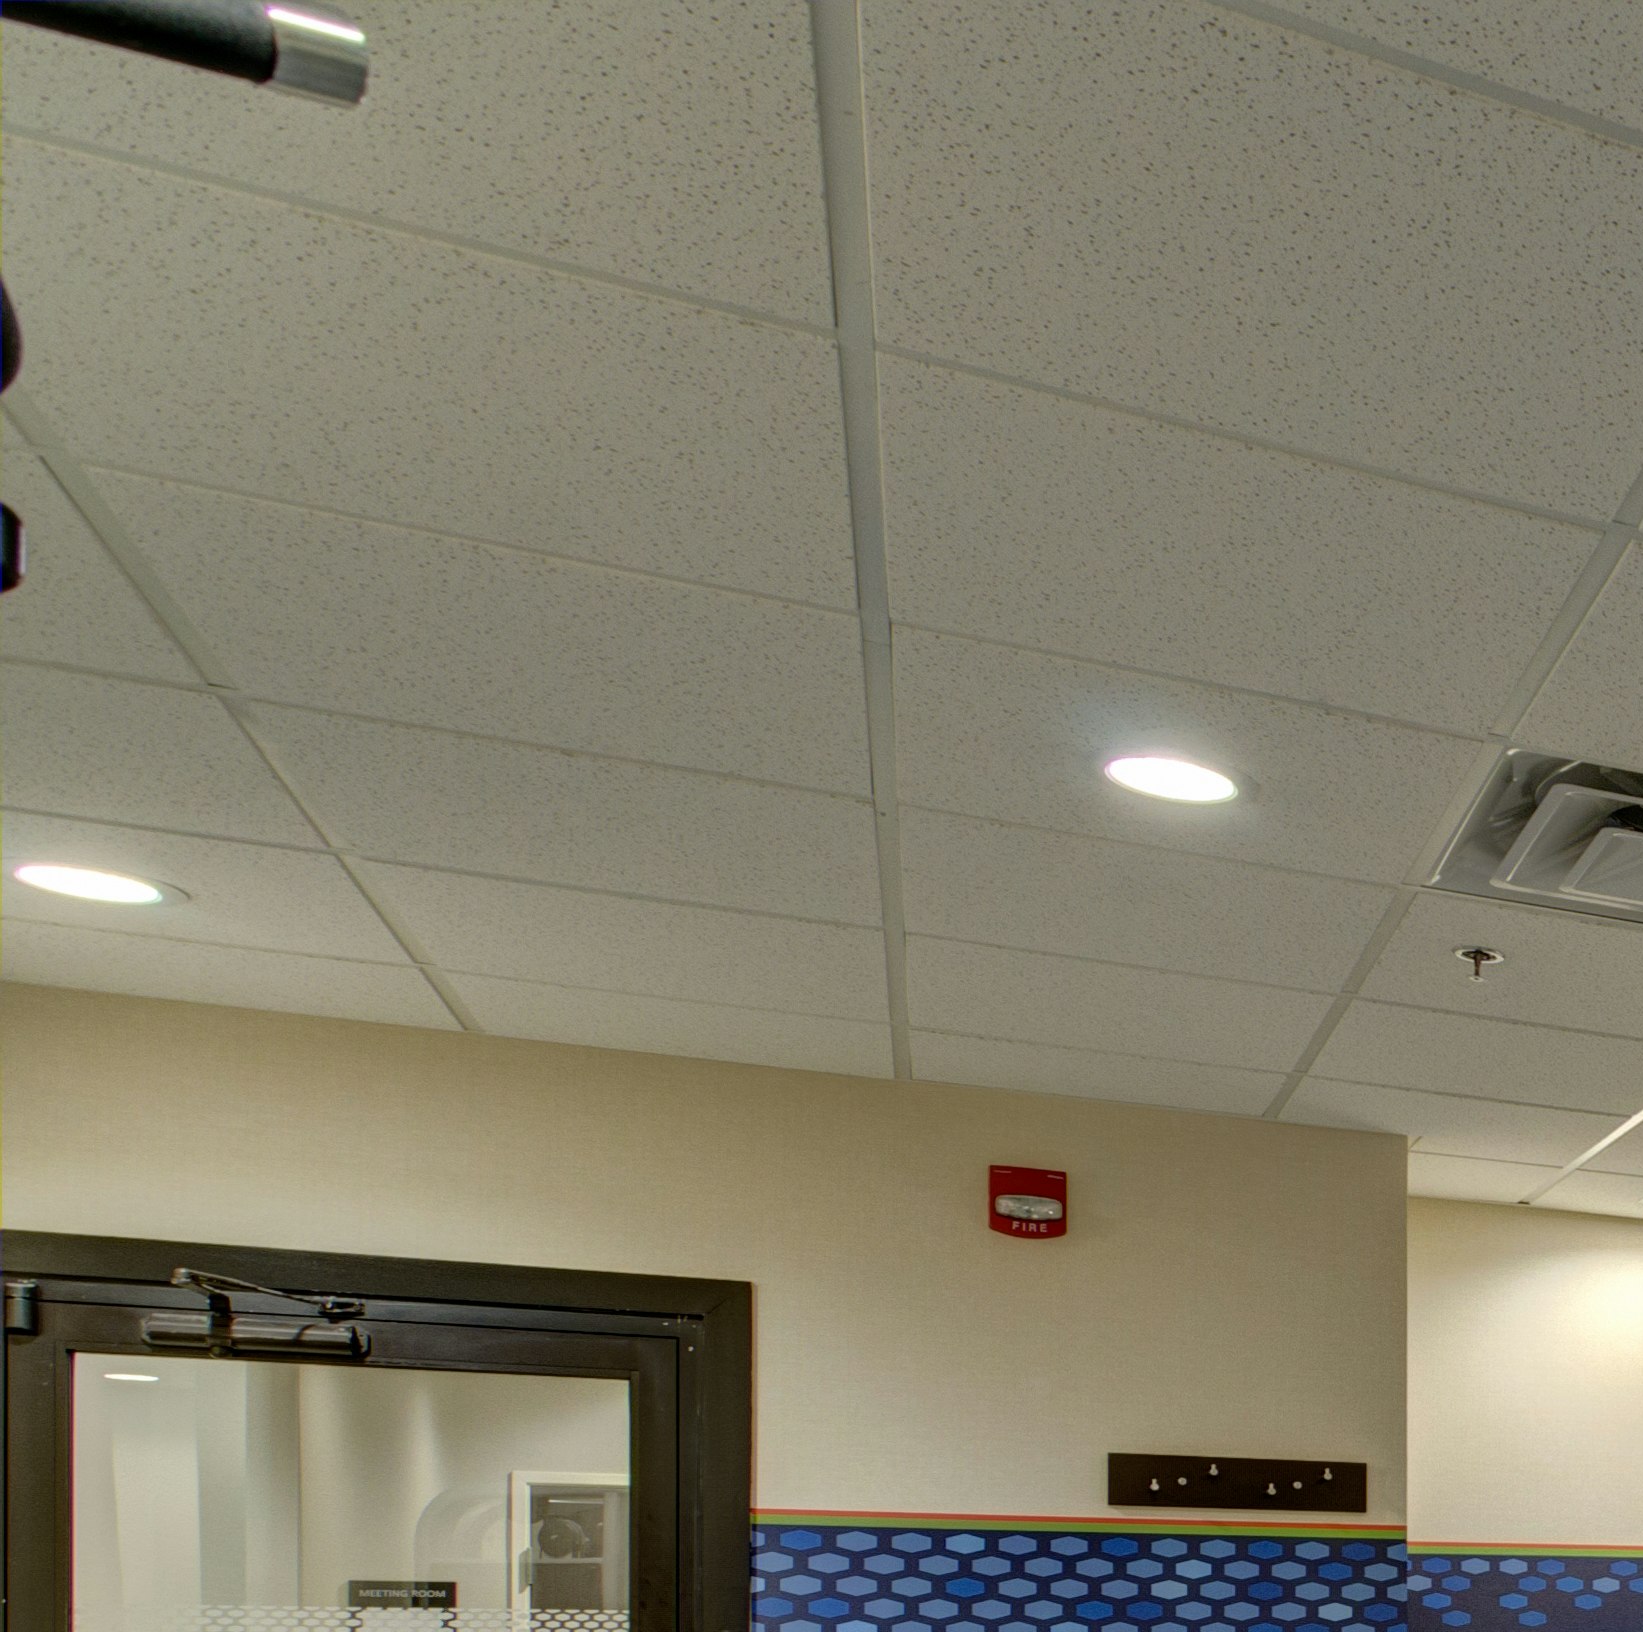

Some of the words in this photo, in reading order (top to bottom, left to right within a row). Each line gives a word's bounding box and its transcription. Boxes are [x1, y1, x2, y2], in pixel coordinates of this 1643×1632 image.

[1012, 1221, 1048, 1233] FIRE
[359, 1589, 408, 1598] MEETING
[411, 1589, 446, 1598] ROOM
